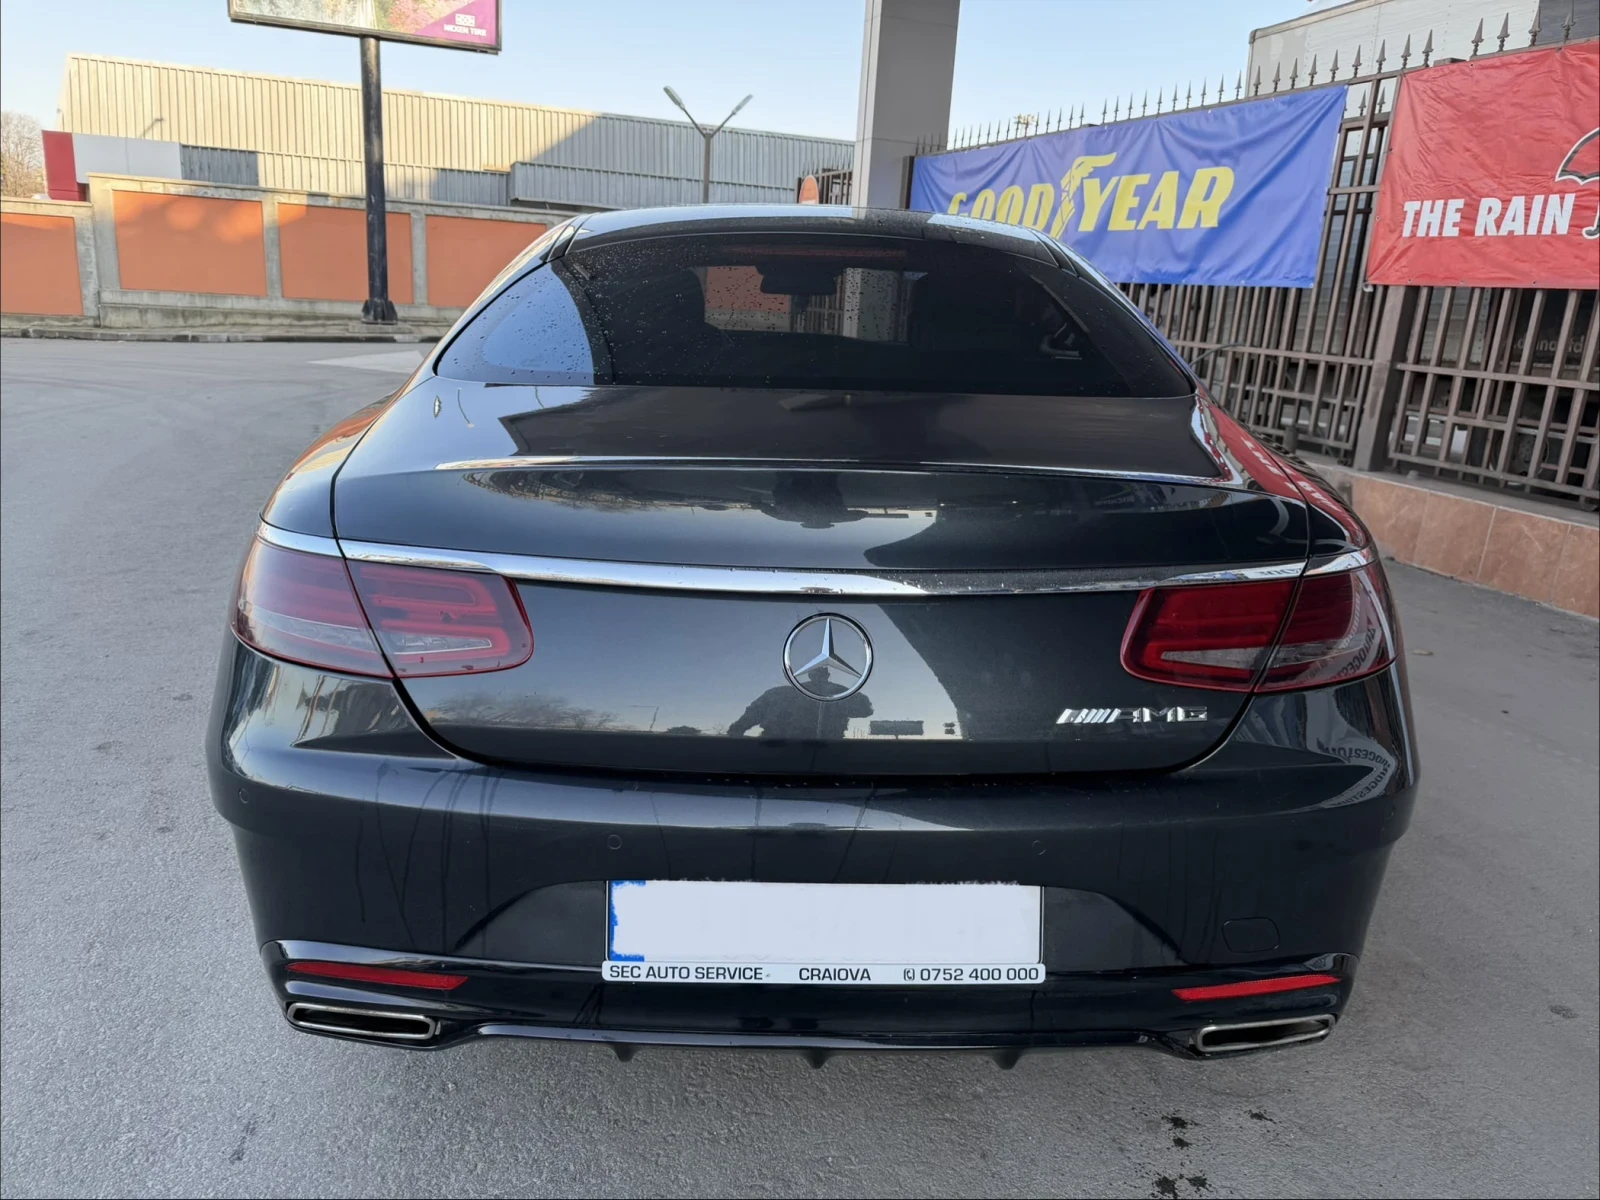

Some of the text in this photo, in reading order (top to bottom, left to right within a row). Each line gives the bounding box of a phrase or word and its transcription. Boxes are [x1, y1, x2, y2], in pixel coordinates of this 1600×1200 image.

[470, 27, 487, 36] TIRE
[1402, 193, 1576, 238] THE RAIN
[609, 965, 1039, 981] SEC AUTO SERVICE CRAIOVA 0752 400 000
